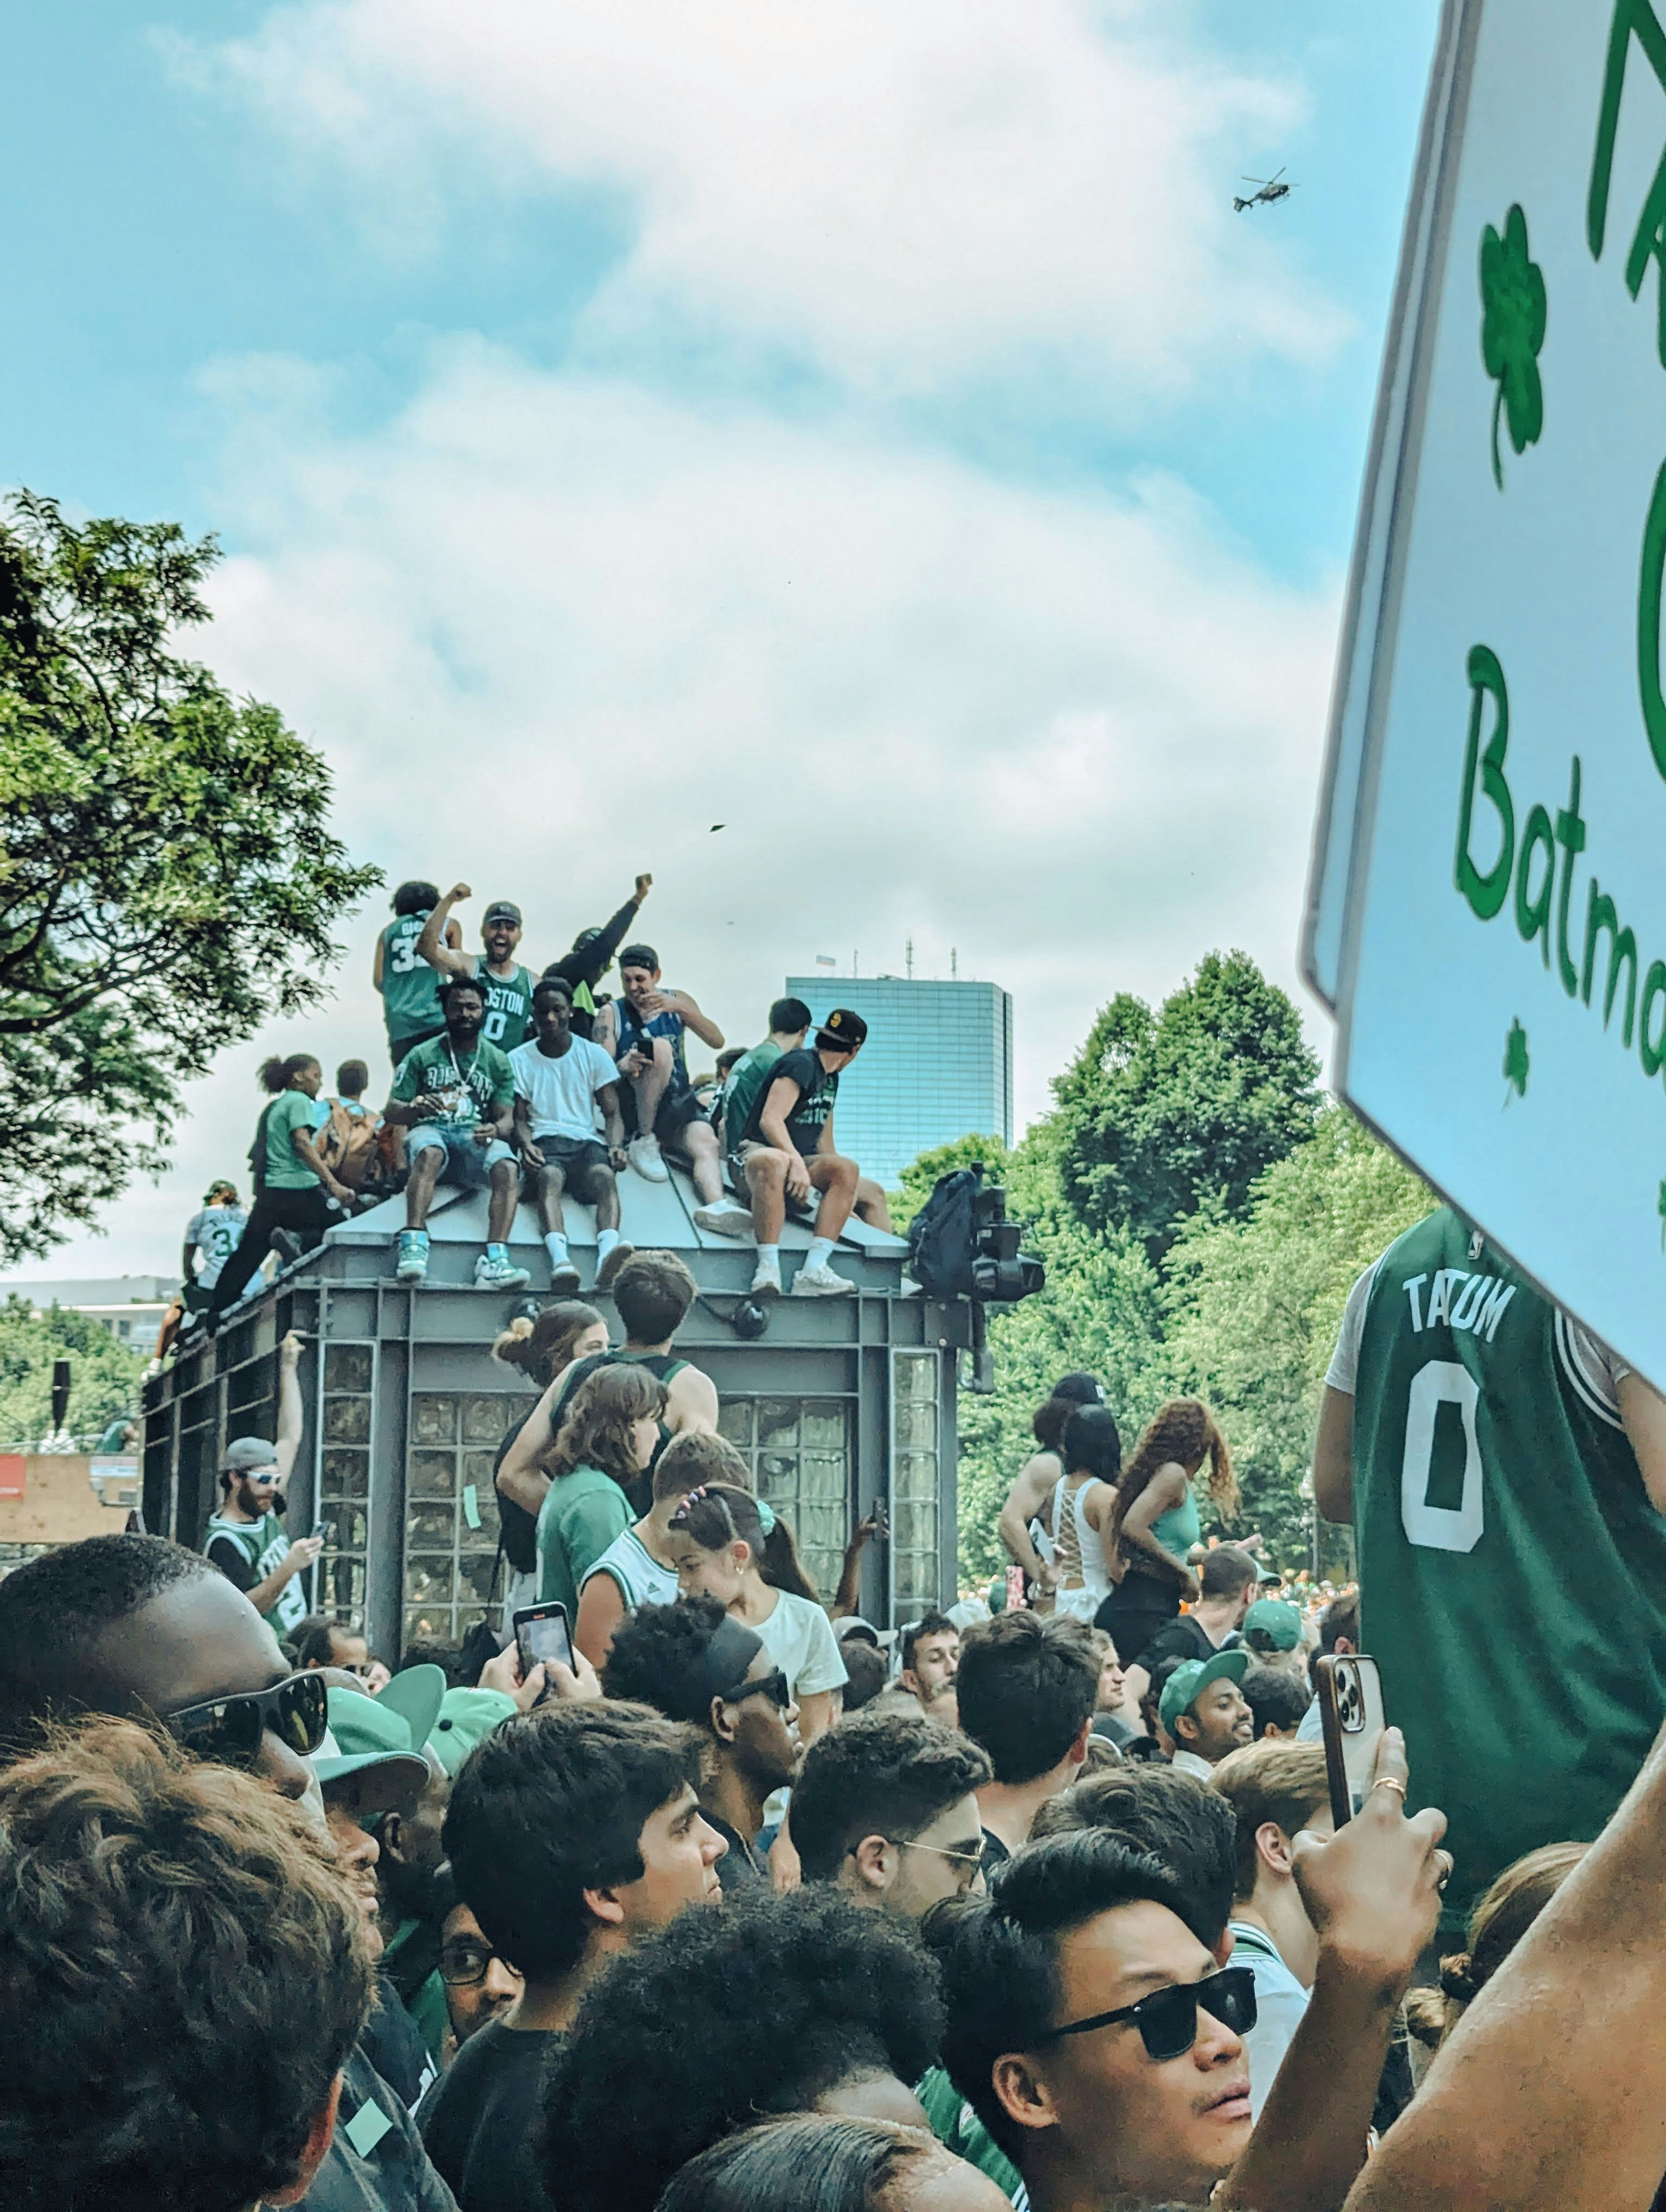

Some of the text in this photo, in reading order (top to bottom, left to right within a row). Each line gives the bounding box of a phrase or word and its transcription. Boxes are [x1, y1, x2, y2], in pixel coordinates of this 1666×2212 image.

[483, 1011, 507, 1040] 0
[484, 987, 524, 1017] OSTON
[1402, 1268, 1516, 1343] TATUM
[1401, 1360, 1484, 1553] 0
